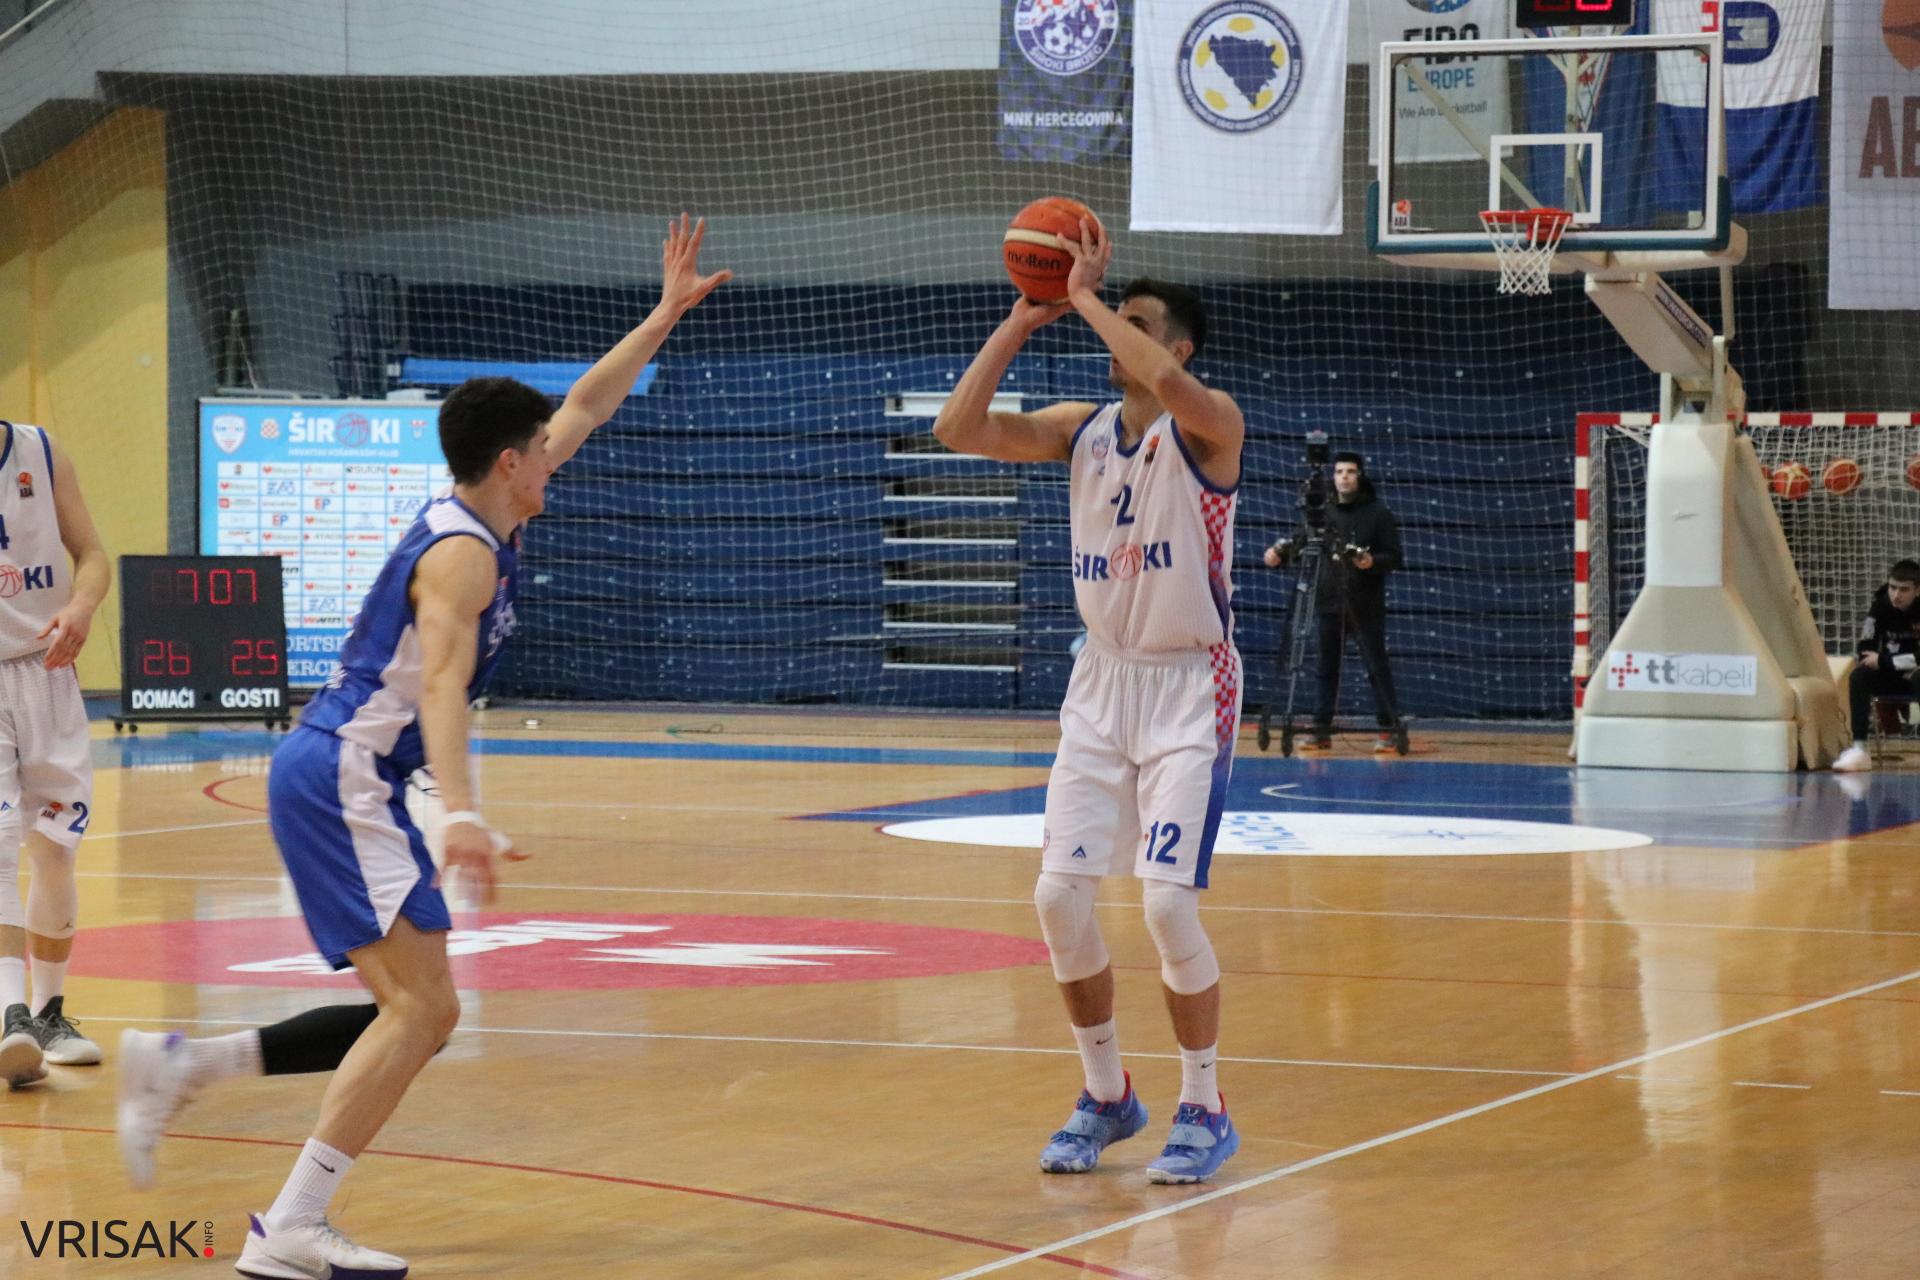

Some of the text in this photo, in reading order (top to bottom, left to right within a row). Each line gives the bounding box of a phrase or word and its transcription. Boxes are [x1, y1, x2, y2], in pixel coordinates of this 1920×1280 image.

[1407, 67, 1476, 92] EROPE
[1003, 110, 1124, 128] MNK HERCEGOVINA
[1008, 249, 1061, 271] molten
[144, 640, 190, 676] 26
[232, 640, 279, 676] 25
[131, 686, 195, 709] DOMAĆI
[220, 687, 281, 708] GOSTI
[1145, 820, 1182, 865] 12
